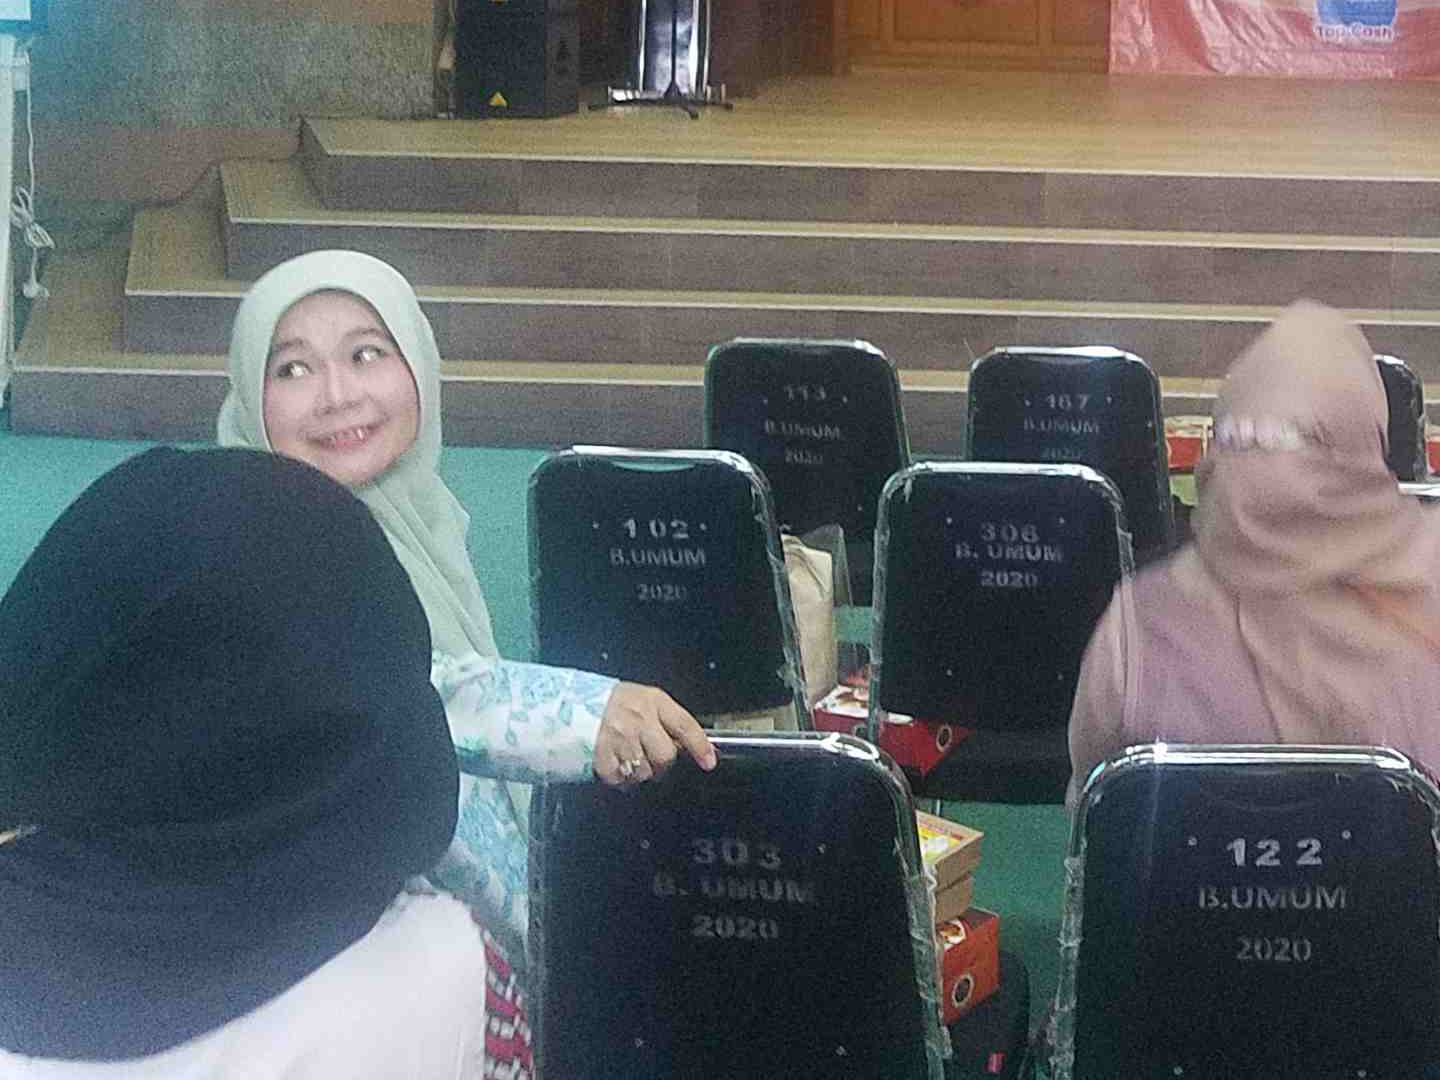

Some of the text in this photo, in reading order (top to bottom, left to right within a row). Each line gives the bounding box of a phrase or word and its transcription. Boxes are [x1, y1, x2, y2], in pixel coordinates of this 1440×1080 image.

[623, 518, 690, 539] 102
[981, 570, 1039, 588] 2020
[692, 915, 779, 939] 2020
[1237, 936, 1312, 961] 2020
